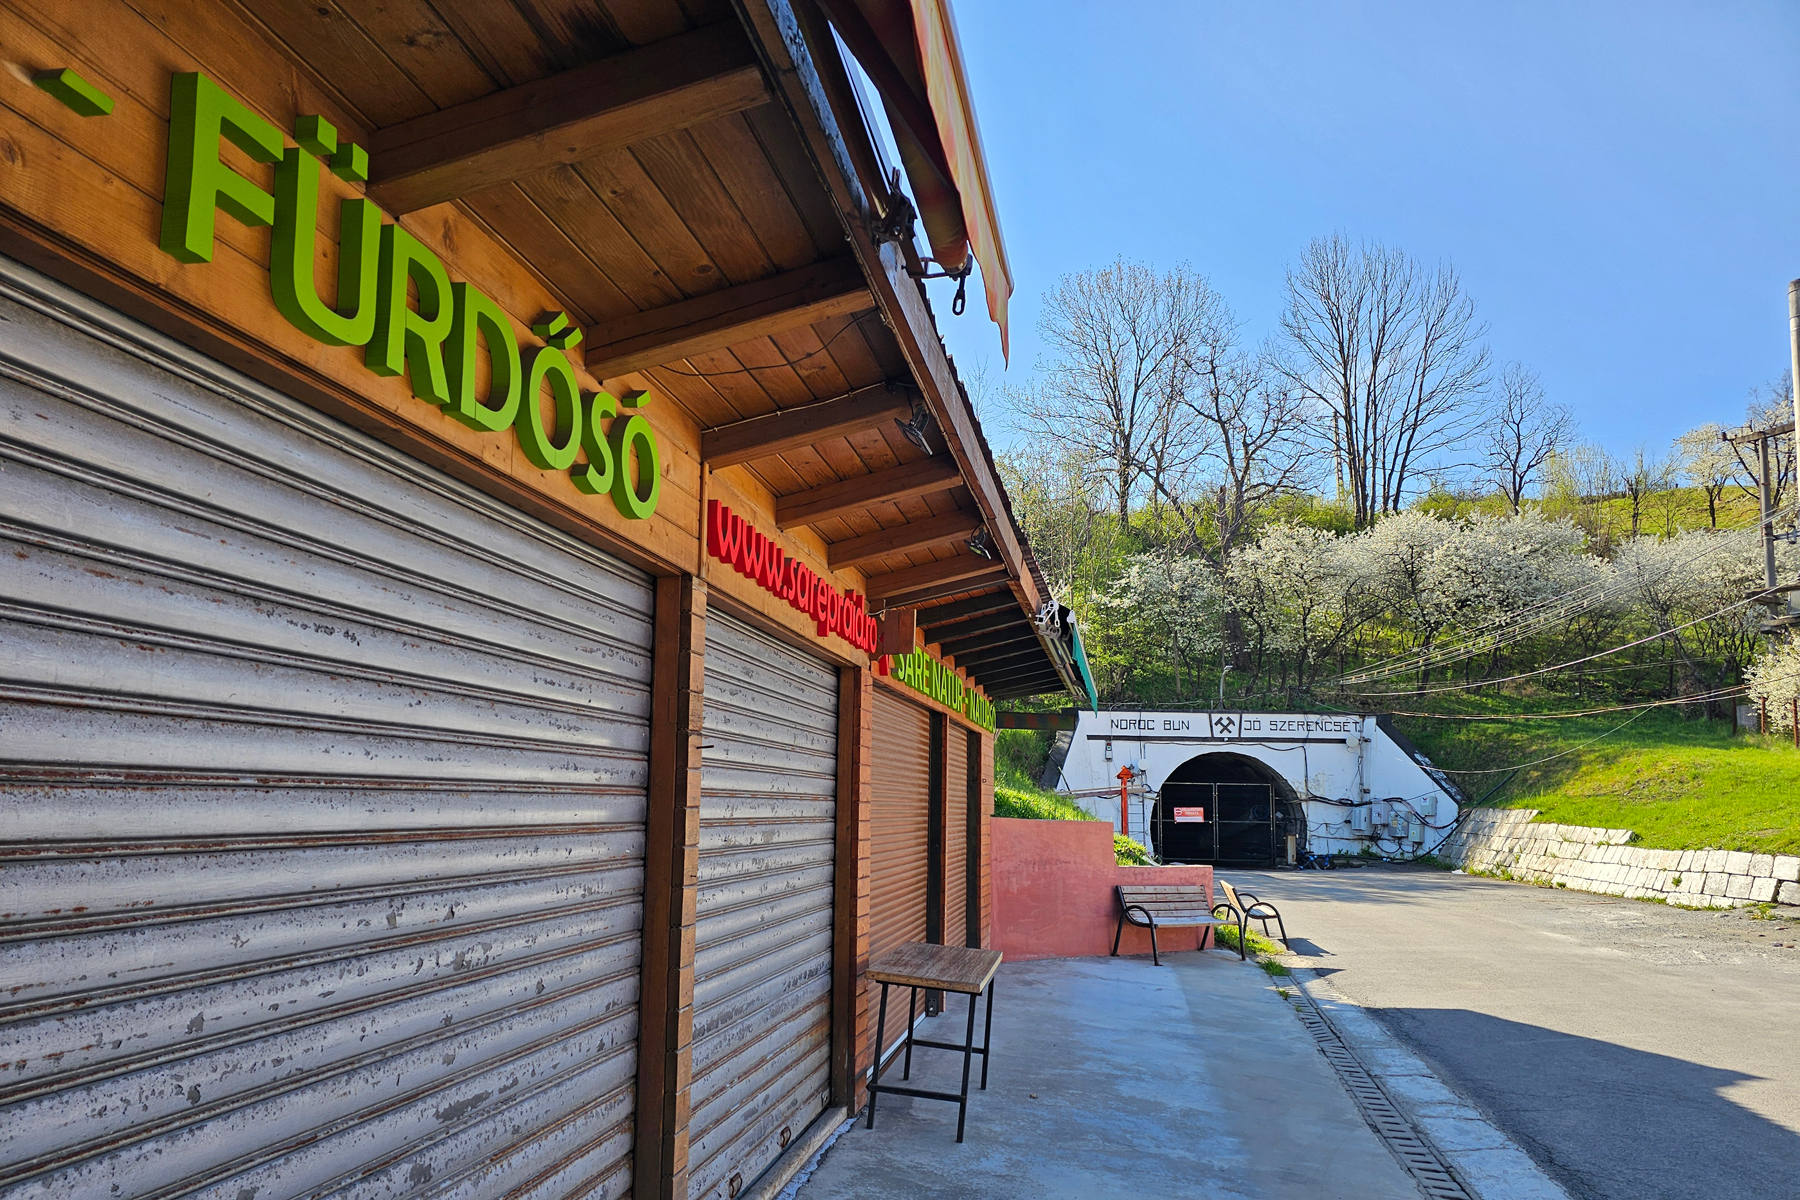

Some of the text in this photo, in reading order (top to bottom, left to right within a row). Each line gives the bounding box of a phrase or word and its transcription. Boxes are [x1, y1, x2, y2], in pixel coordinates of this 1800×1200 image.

[160, 71, 660, 519] FÜRDŐSÓ
[707, 499, 878, 654] www.sarepraid.ro
[930, 658, 963, 714] NATUR
[1110, 718, 1190, 731] NOROC BUN
[1243, 717, 1261, 731] JÓ
